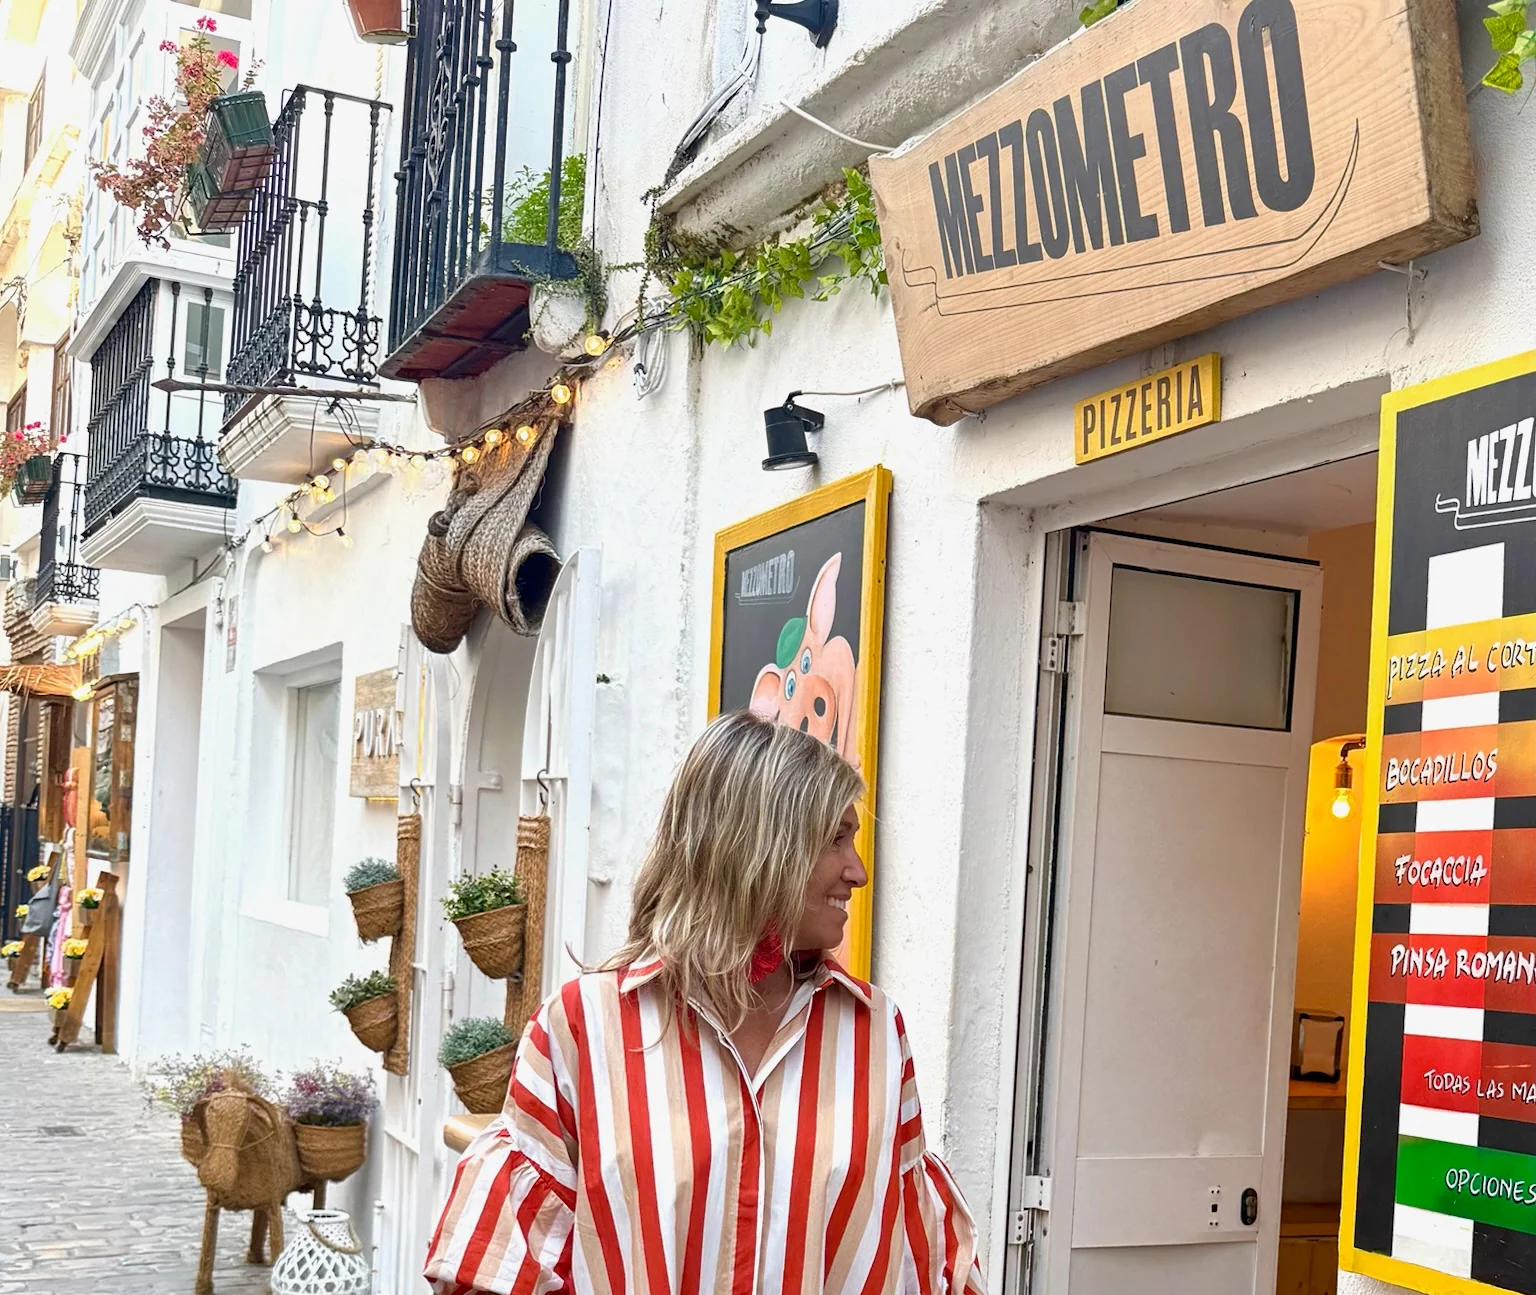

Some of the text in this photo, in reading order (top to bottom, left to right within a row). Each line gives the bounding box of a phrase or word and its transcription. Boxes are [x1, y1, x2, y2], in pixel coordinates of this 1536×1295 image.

[928, 0, 1316, 280] MEZZOMETRO
[1083, 365, 1205, 455] PIZZERIA
[1465, 416, 1536, 508] MEZZ
[741, 550, 796, 598] MEZZOMETRO
[1387, 647, 1448, 700] PIZZA
[1450, 643, 1480, 680] AL
[353, 706, 398, 759] PURA
[1385, 748, 1499, 791] BOCADILLOS
[1393, 853, 1488, 888] FOCACCIA
[1389, 944, 1536, 985] PINSA ROMAN
[1423, 1068, 1471, 1095] TODAS
[1475, 1079, 1505, 1100] LAS
[1444, 1168, 1536, 1206] OPCIONES
